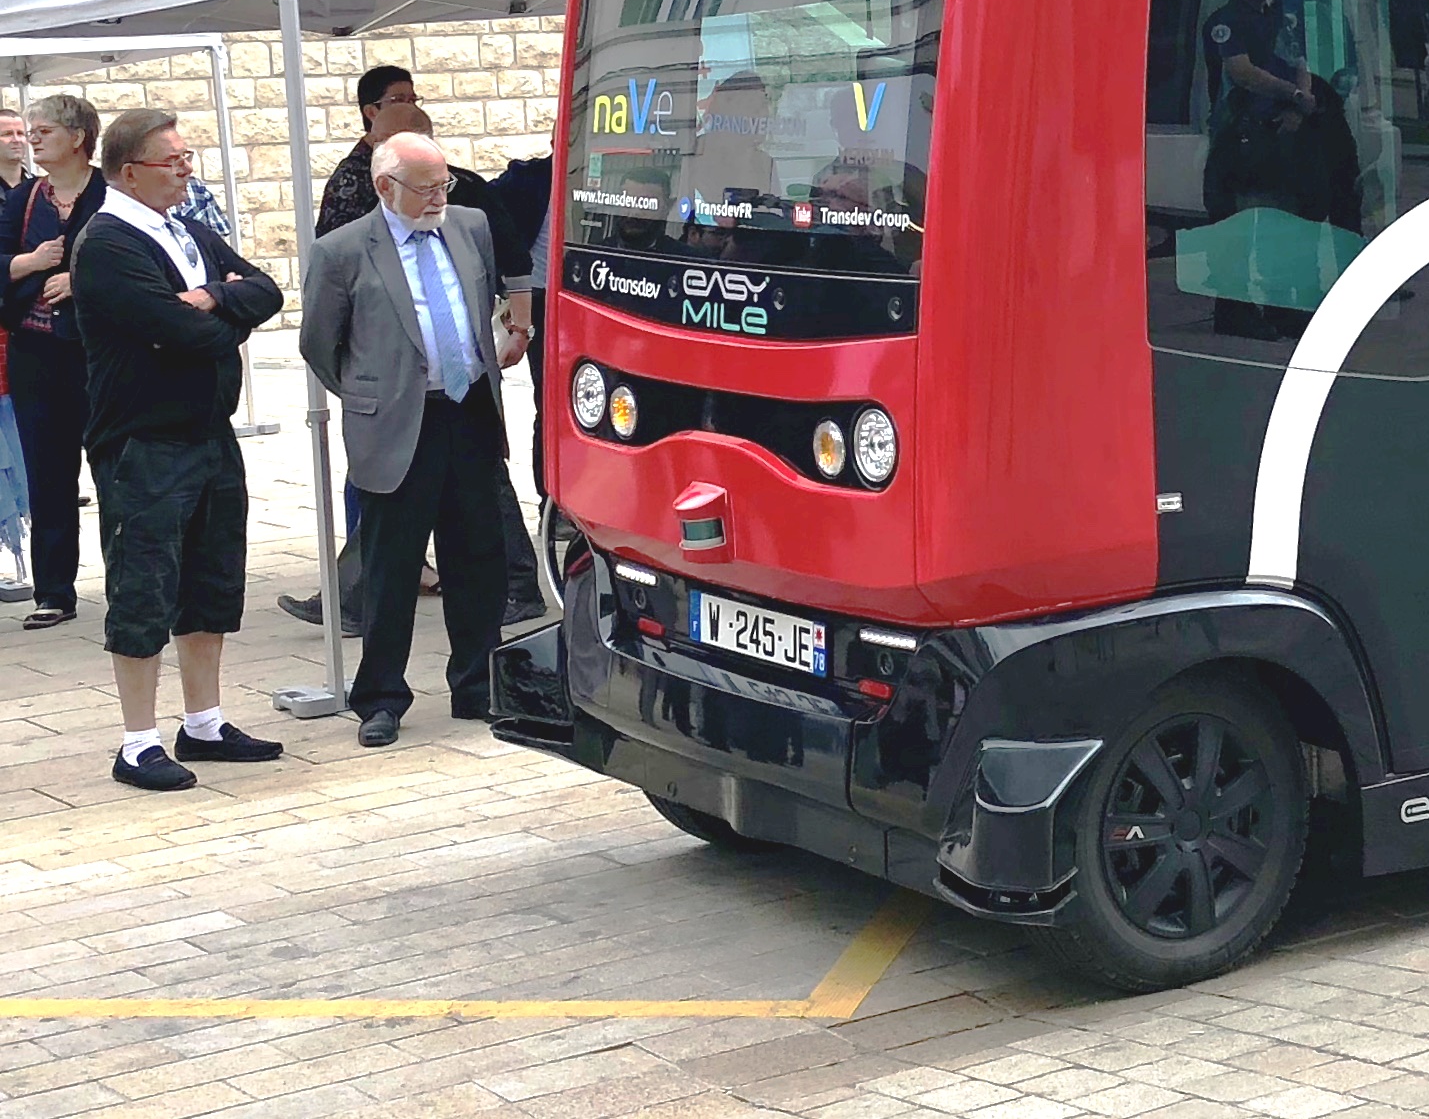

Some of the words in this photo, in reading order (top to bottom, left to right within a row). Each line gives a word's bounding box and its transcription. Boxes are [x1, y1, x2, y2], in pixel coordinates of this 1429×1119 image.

[852, 81, 887, 132] V
[572, 189, 659, 211] www.transdev.com
[694, 198, 753, 219] TransdevFR
[820, 206, 872, 226] Transdev
[873, 209, 910, 232] Group
[608, 271, 661, 299] transdev
[813, 651, 826, 672] 78
